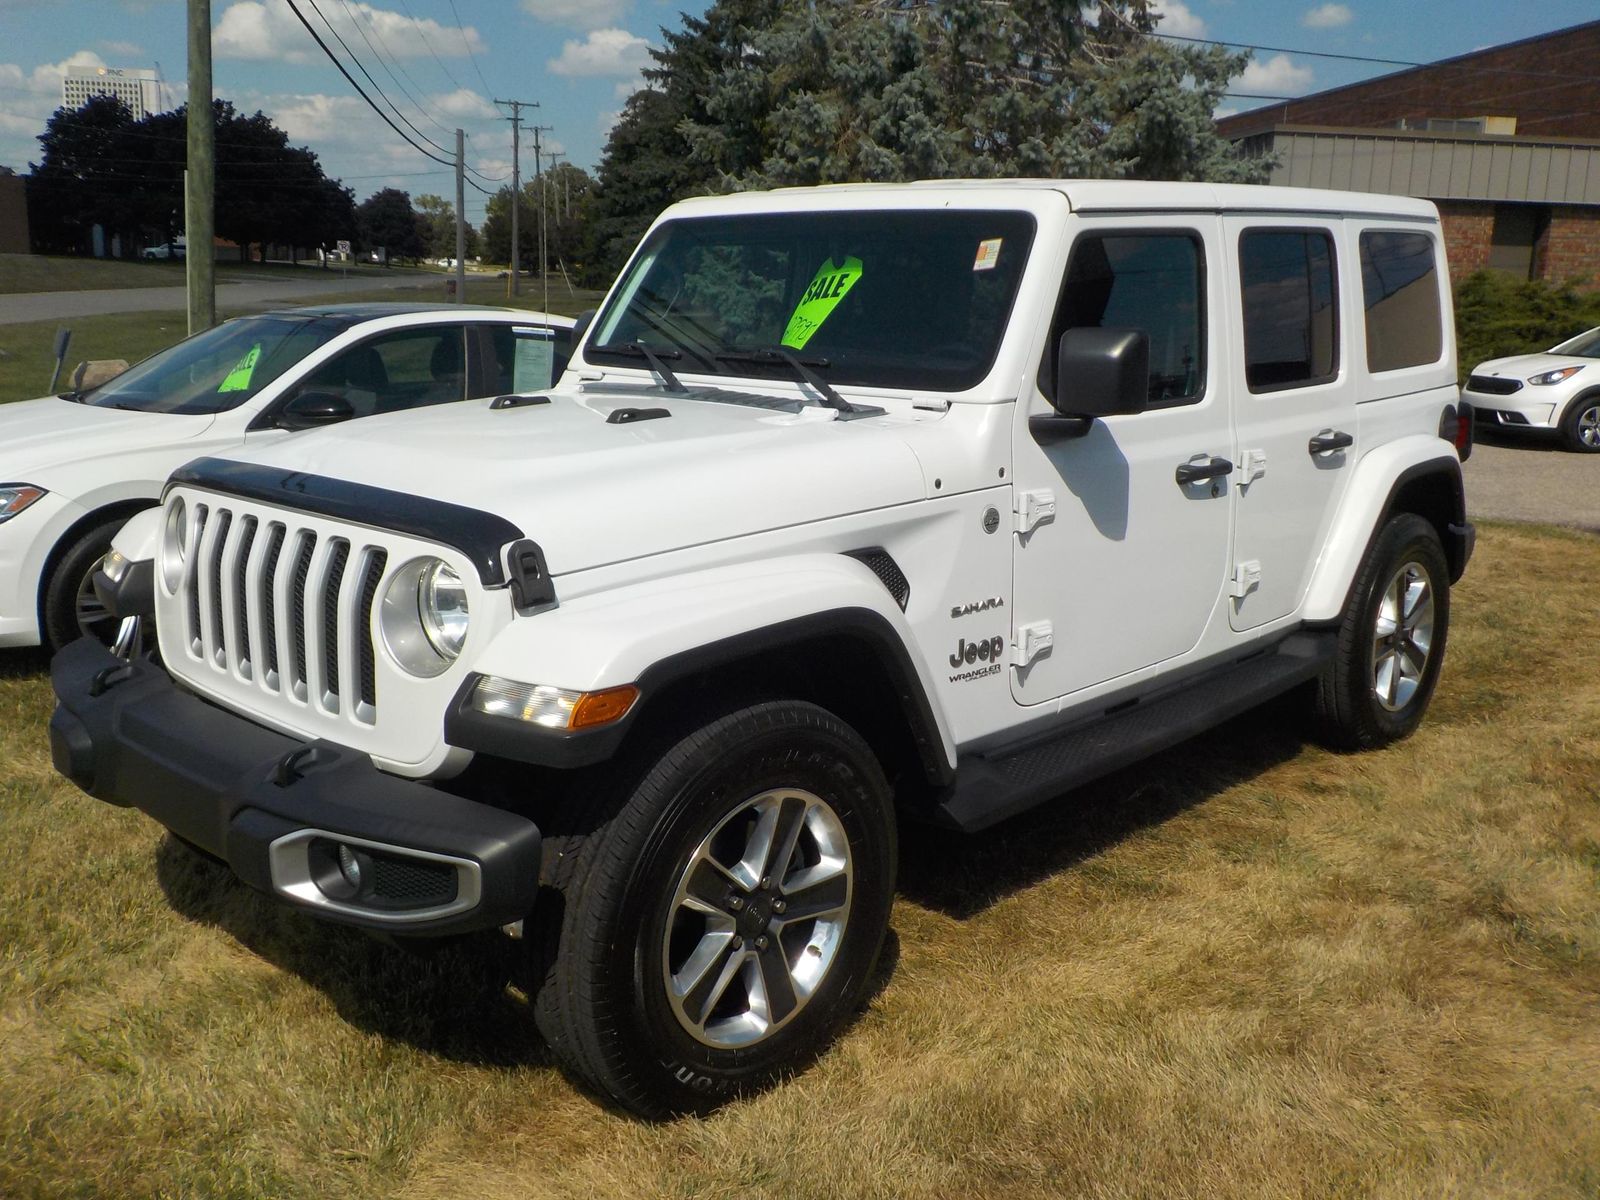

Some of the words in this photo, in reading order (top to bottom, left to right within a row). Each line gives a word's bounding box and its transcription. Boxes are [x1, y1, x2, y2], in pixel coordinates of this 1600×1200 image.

[802, 273, 850, 306] SALE
[951, 597, 1003, 618] SAHARA
[949, 635, 1003, 668] Jeep
[949, 664, 1001, 683] WRANGLER
